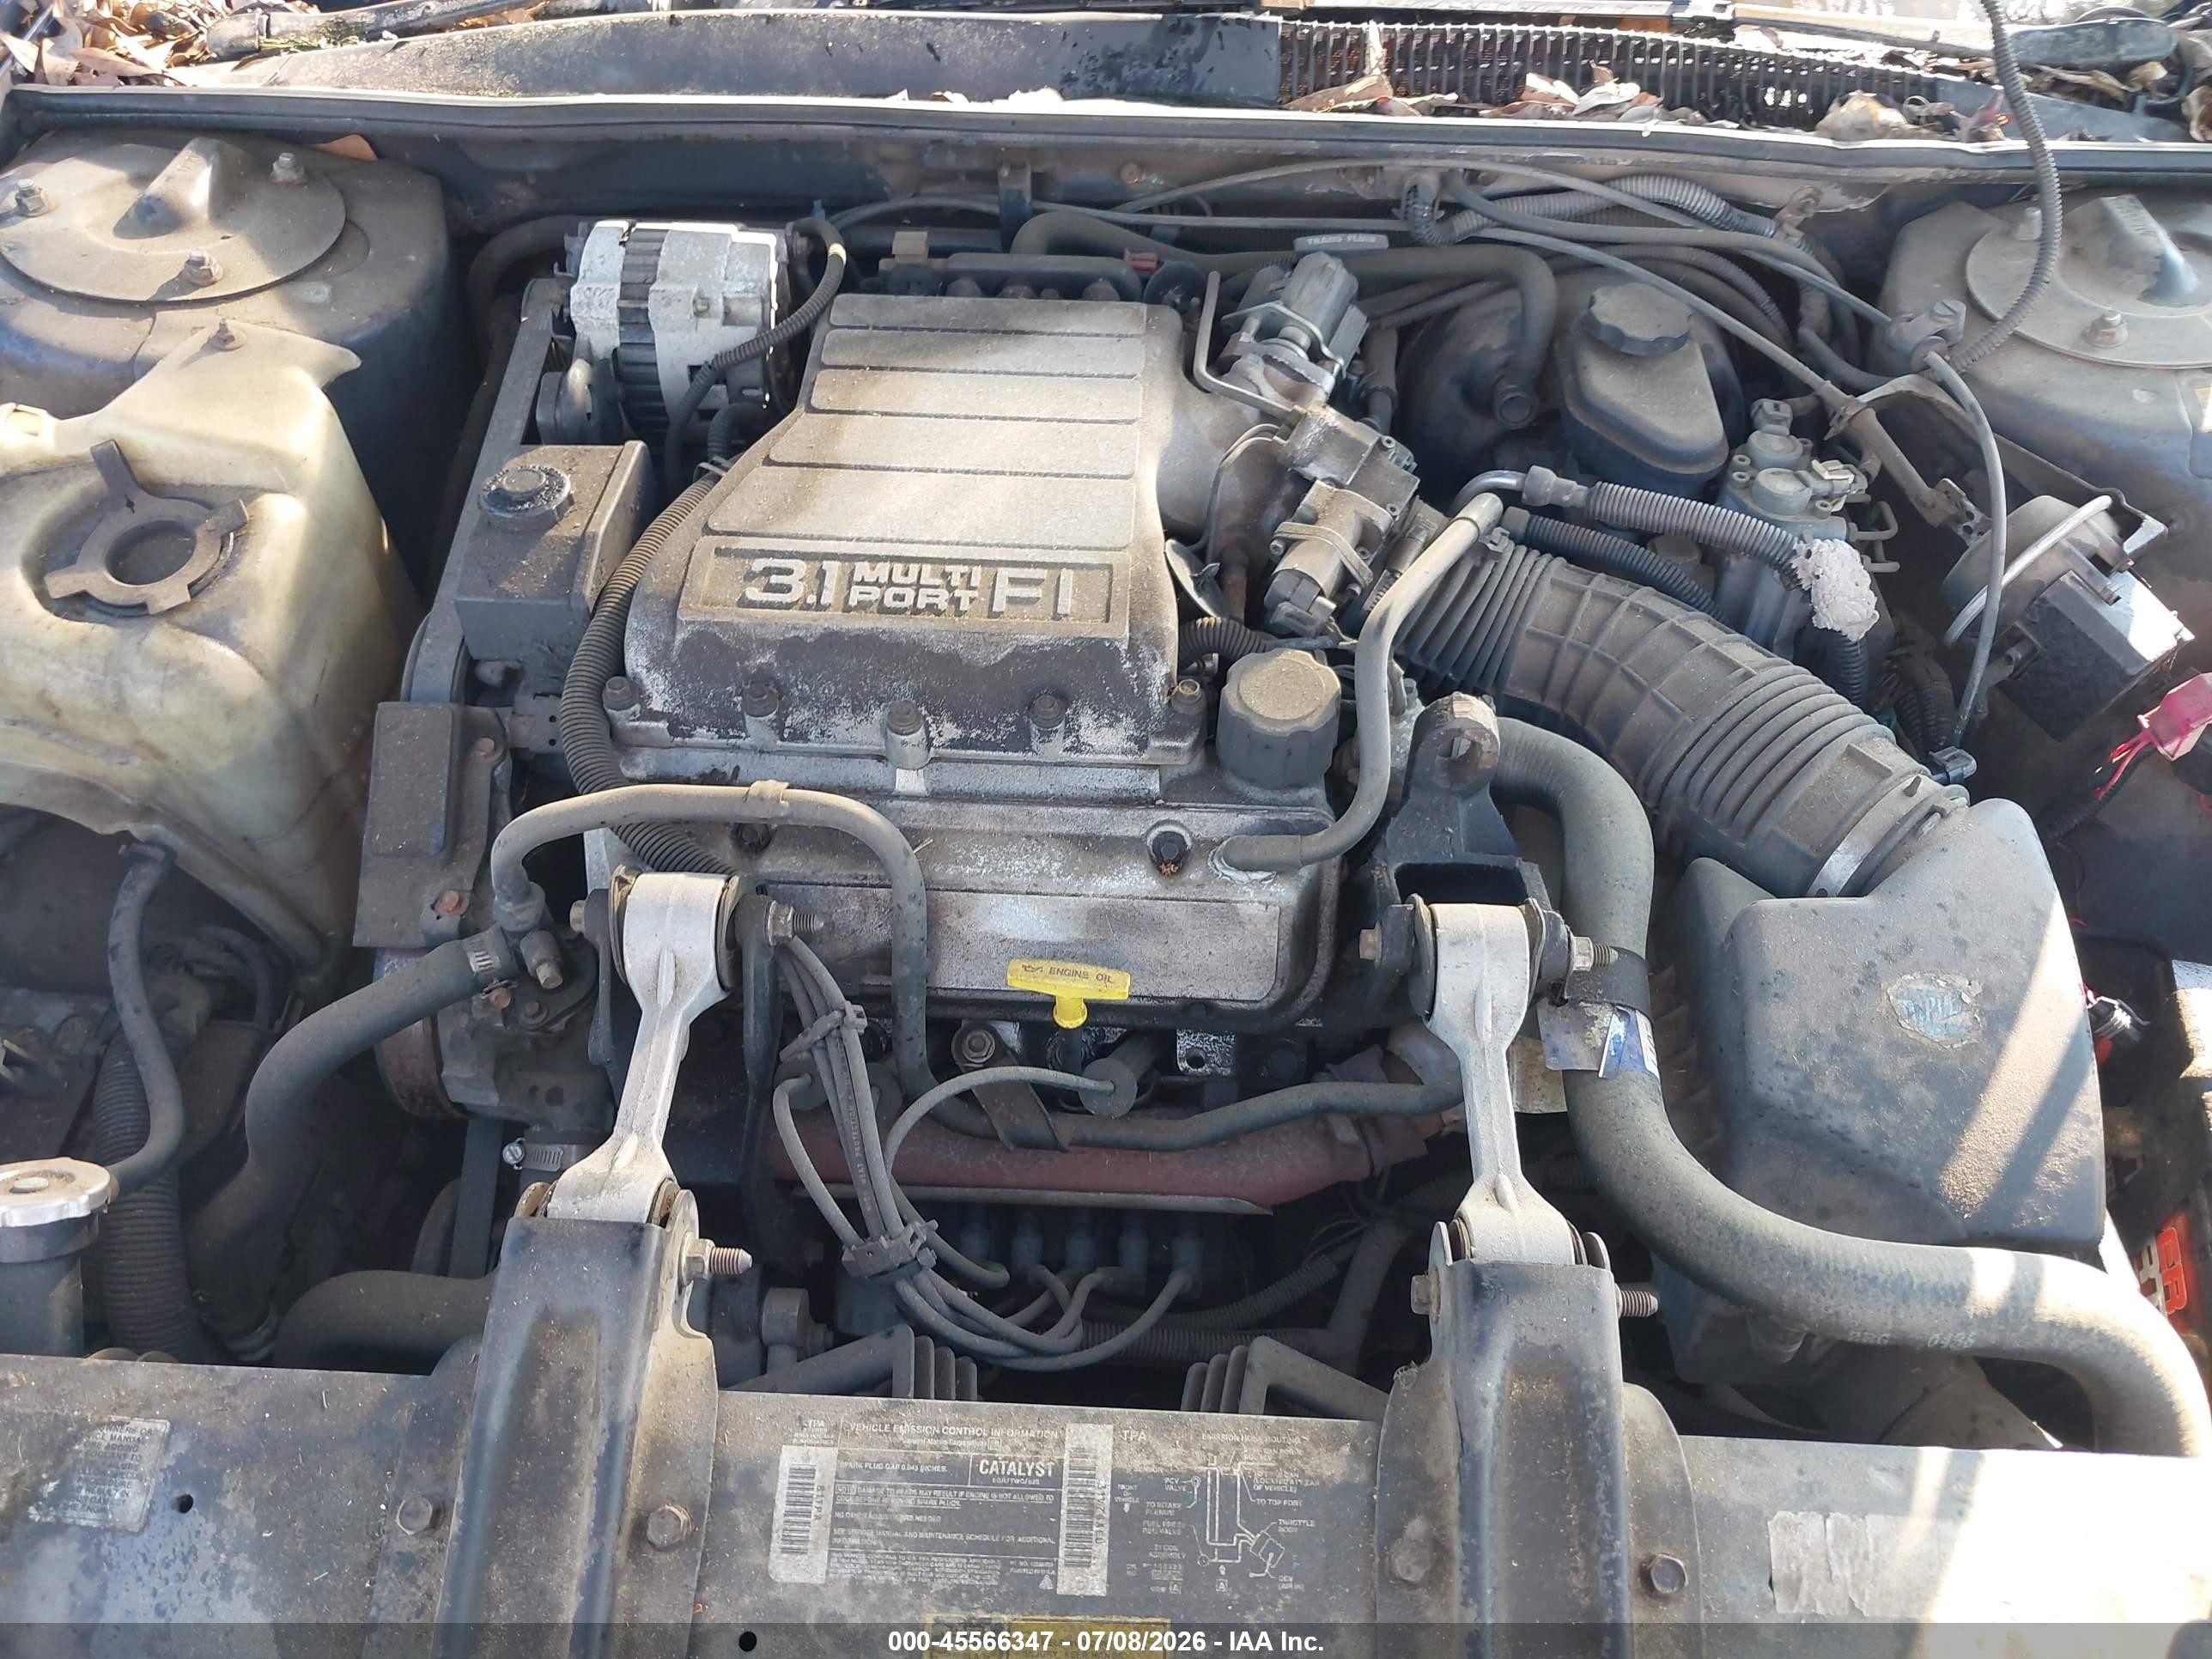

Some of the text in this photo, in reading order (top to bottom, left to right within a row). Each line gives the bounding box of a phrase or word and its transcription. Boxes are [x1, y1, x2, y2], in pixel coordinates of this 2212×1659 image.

[744, 557, 841, 605] 3.1
[852, 561, 982, 587] MULTI
[847, 585, 980, 611] PORT
[992, 566, 1073, 616] FI
[1048, 966, 1114, 984] ENGINE OIL
[857, 1163, 867, 1184] HEAT
[850, 1422, 1058, 1439] VEHICLE EMISSION CONTROL INFORMATION
[1121, 1429, 1147, 1442] TPA
[865, 1462, 884, 1470] PLUG
[979, 1459, 1055, 1477] CATALYST
